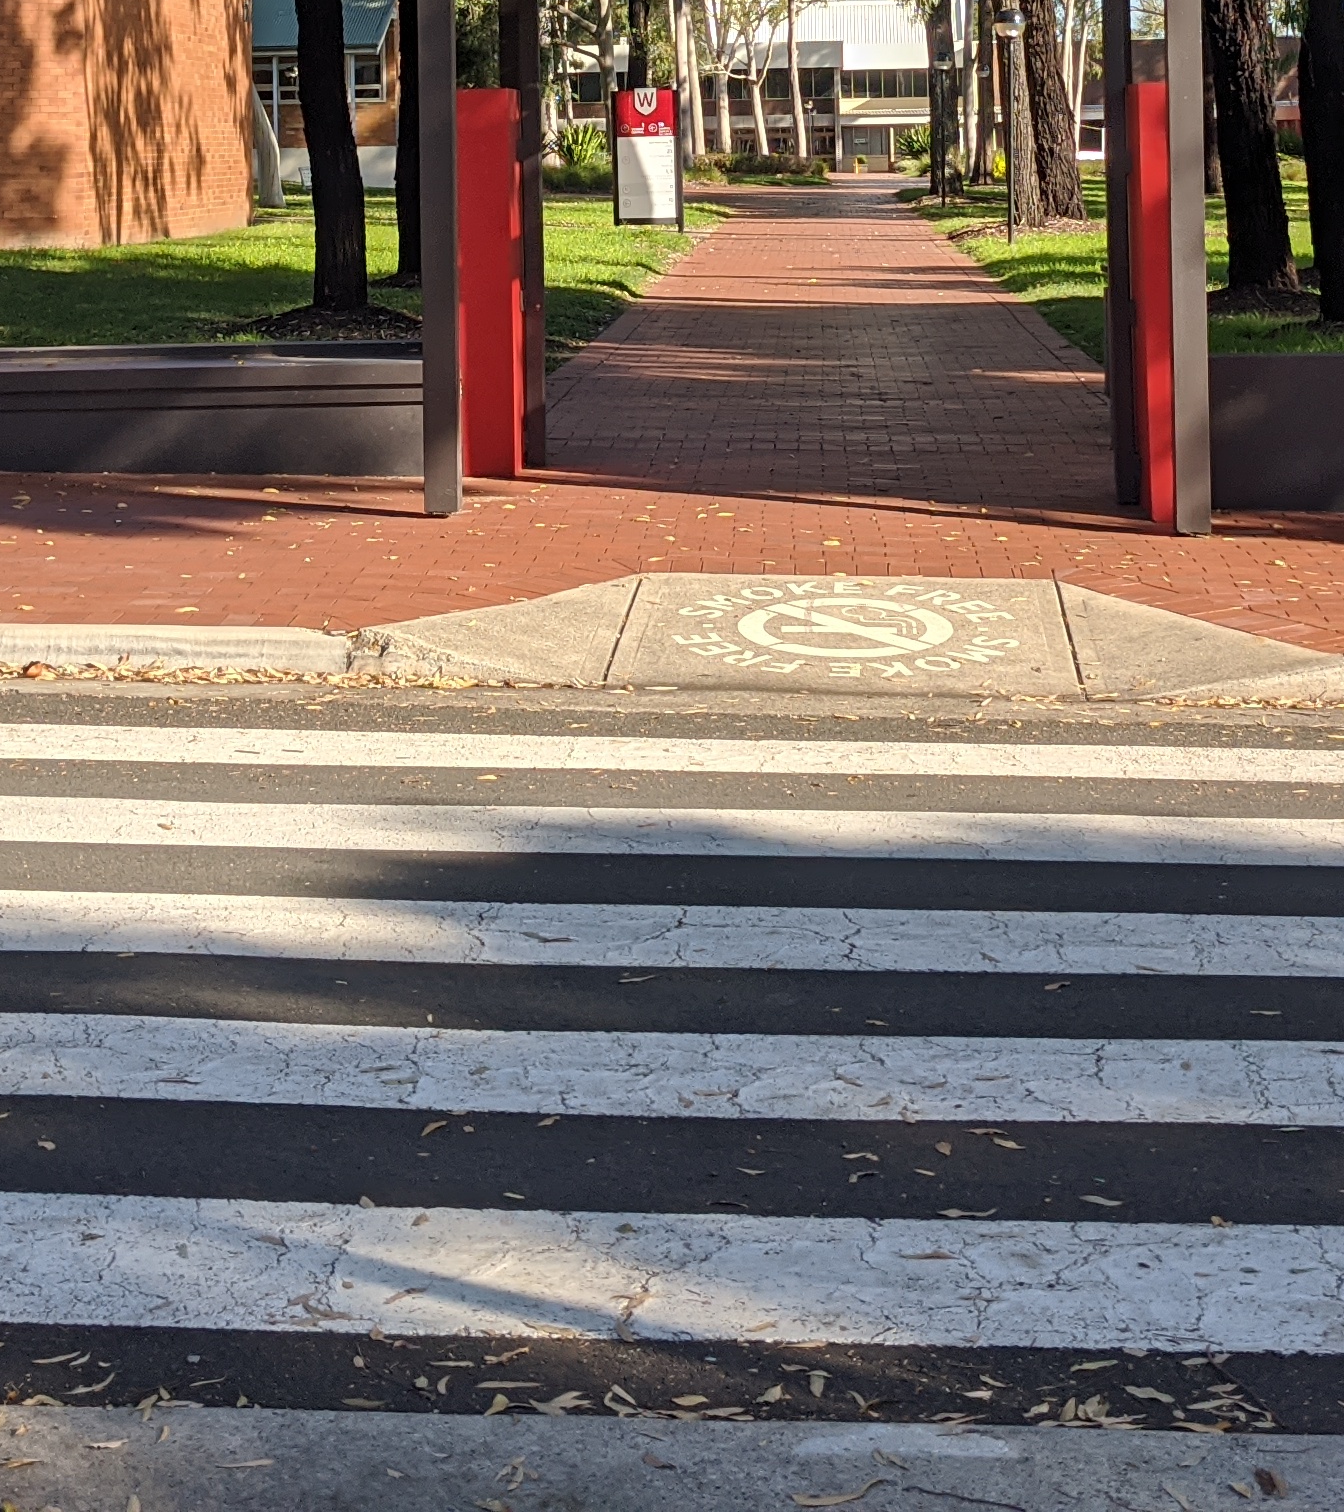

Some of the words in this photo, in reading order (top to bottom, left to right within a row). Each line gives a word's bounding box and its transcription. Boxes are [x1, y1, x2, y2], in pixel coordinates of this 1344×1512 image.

[637, 92, 654, 107] W
[678, 581, 863, 619] SMOKE
[884, 584, 1017, 623] FREE
[671, 632, 807, 674] FREE
[829, 636, 1020, 678] SMOKE
